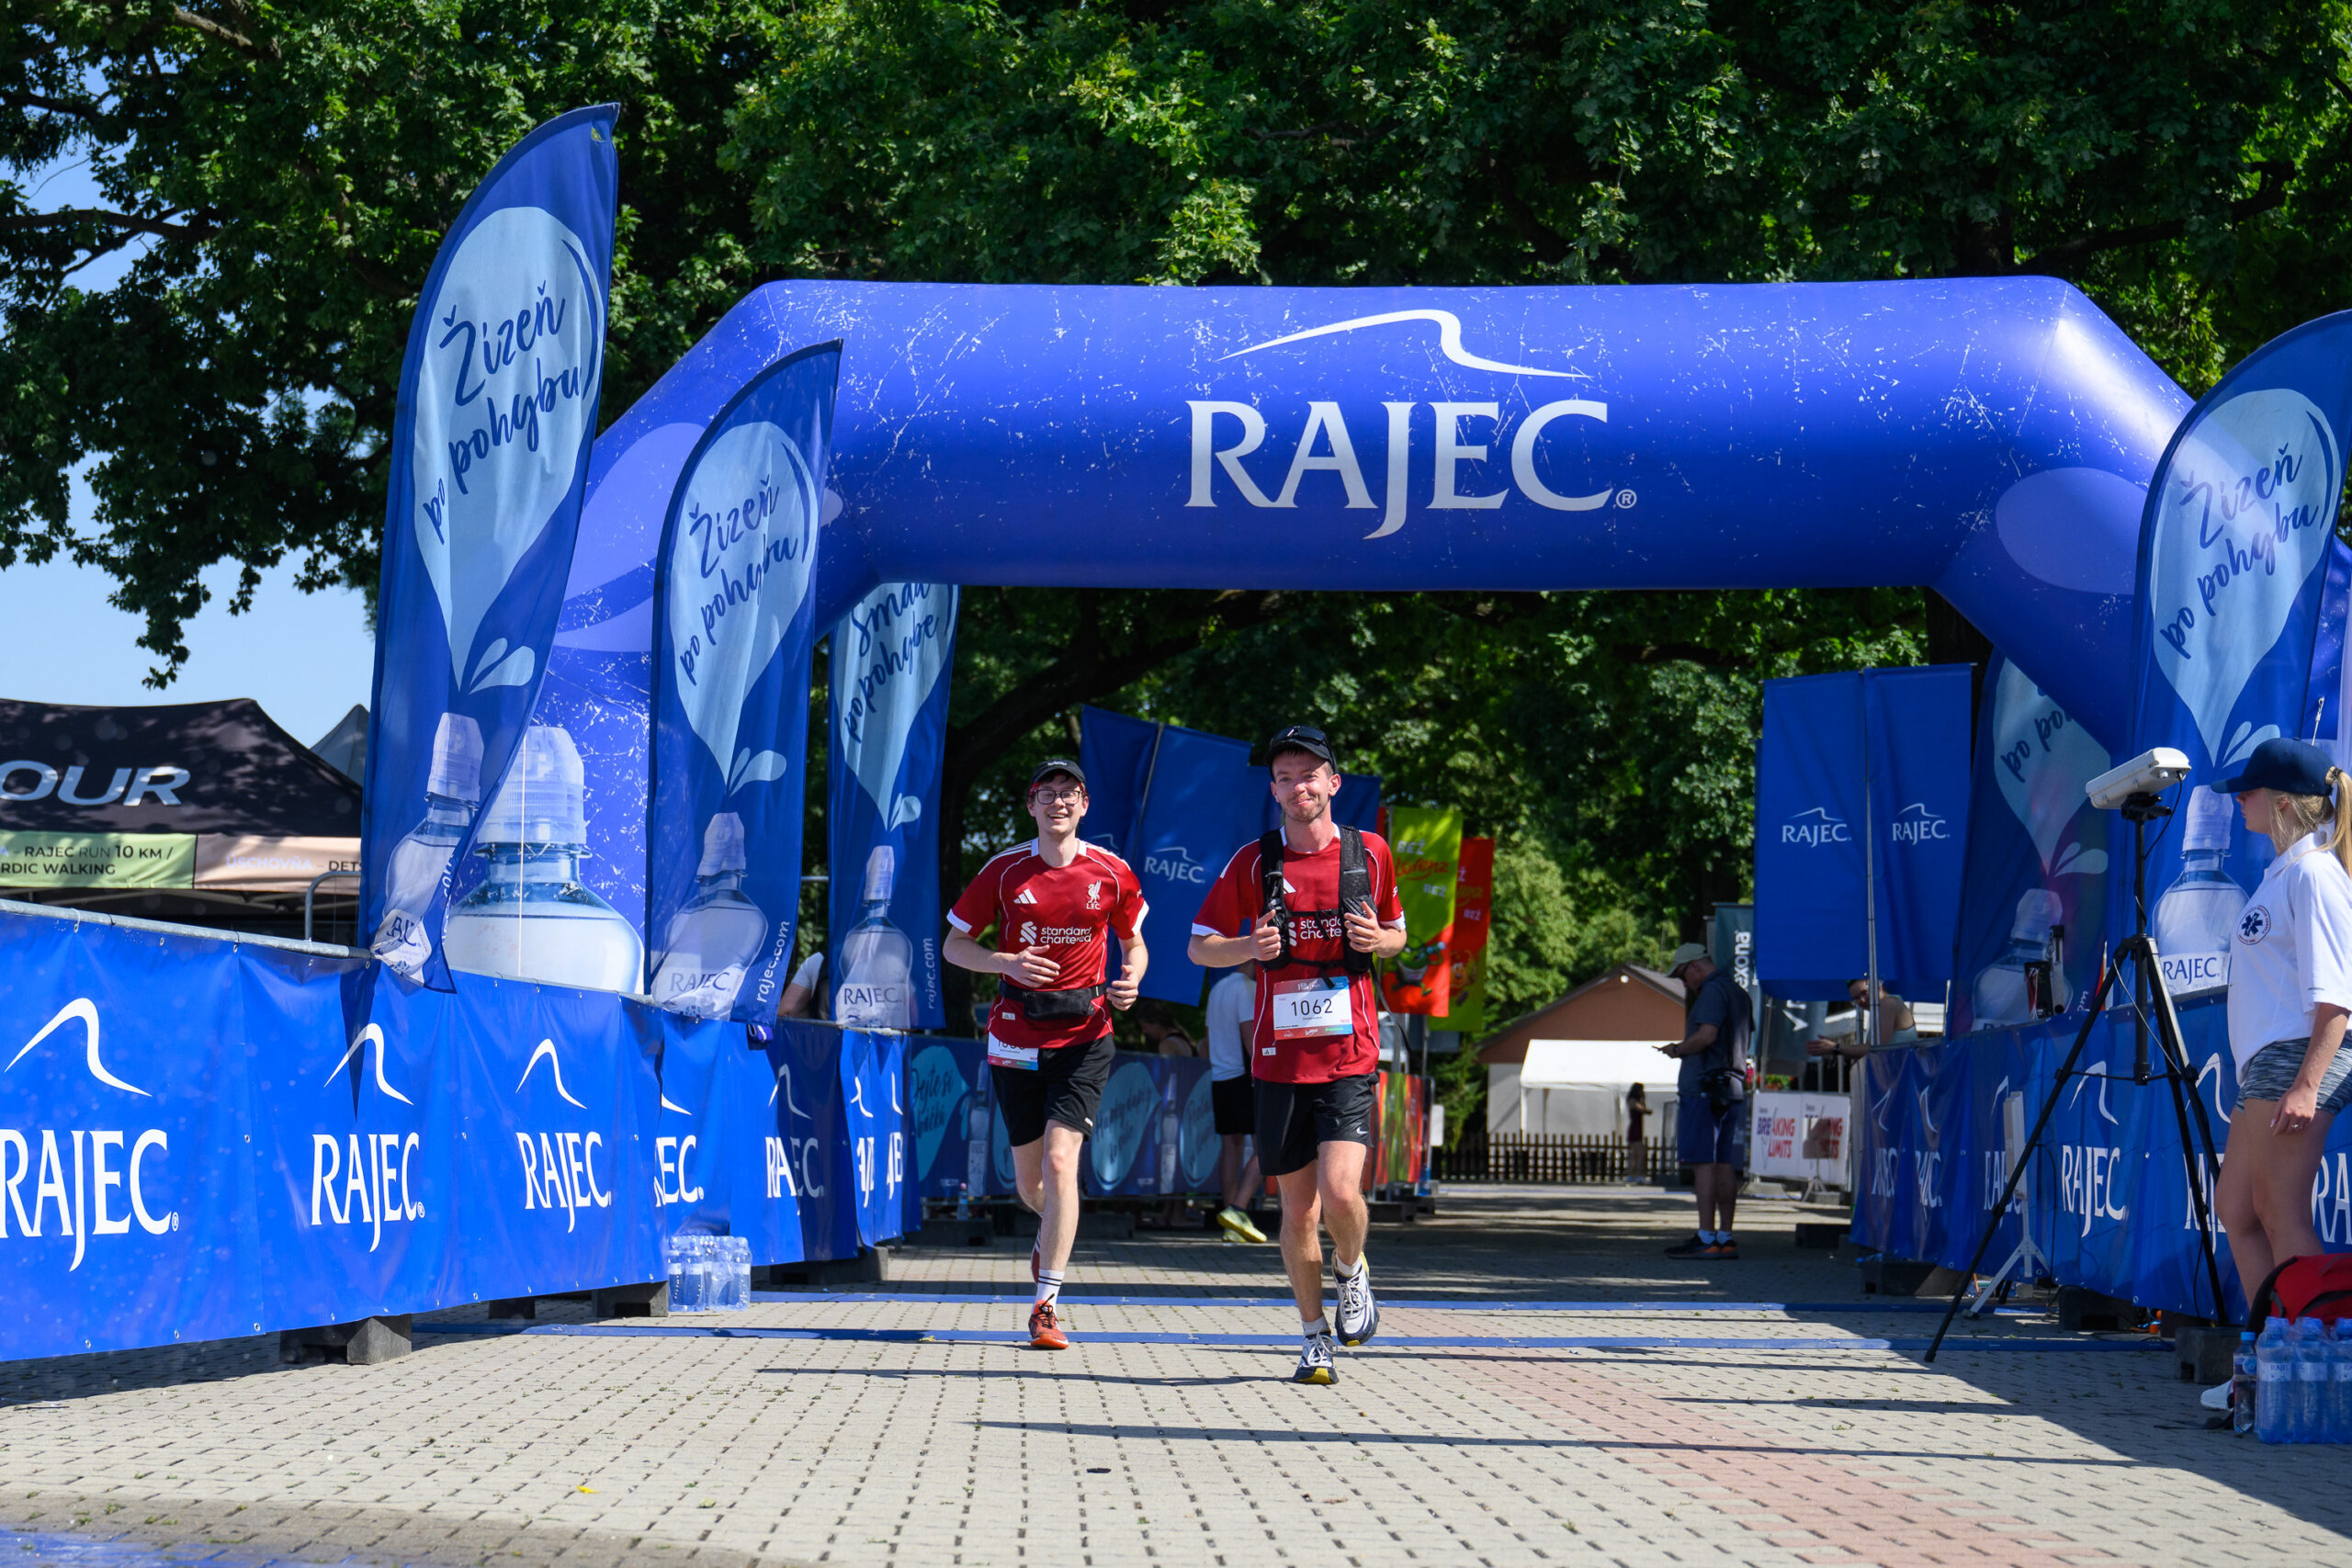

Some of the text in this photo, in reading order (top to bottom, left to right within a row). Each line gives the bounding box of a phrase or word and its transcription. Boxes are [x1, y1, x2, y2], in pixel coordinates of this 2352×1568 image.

[422, 357, 582, 545] po pohybu
[1184, 400, 1613, 540] RAJEC
[2159, 502, 2320, 660] po pohybu
[679, 533, 798, 686] po pohybu
[844, 610, 939, 744] po pohybe
[1999, 740, 2030, 784] po
[24, 846, 74, 858] RAJEC
[79, 847, 111, 859] RUN
[116, 845, 134, 859] 10
[139, 848, 163, 860] KM
[1781, 823, 1848, 848] RAJEC
[1892, 819, 1947, 846] RAJEC
[43, 863, 116, 875] WALKING
[1144, 856, 1204, 884] RAJEC
[1040, 933, 1092, 944] chartered
[1041, 926, 1092, 936] standard
[669, 972, 730, 992] RAJEC
[756, 920, 790, 1003] rajec.com
[922, 938, 937, 1010] rajec.com
[2163, 956, 2218, 986] RAJEC
[843, 987, 899, 1007] RAJEC
[1291, 998, 1333, 1017] 1062
[0, 1129, 172, 1272] RAJEC
[311, 1132, 420, 1253] RAJEC
[516, 1131, 608, 1234] RAJEC
[2061, 1145, 2126, 1238] RAJEC
